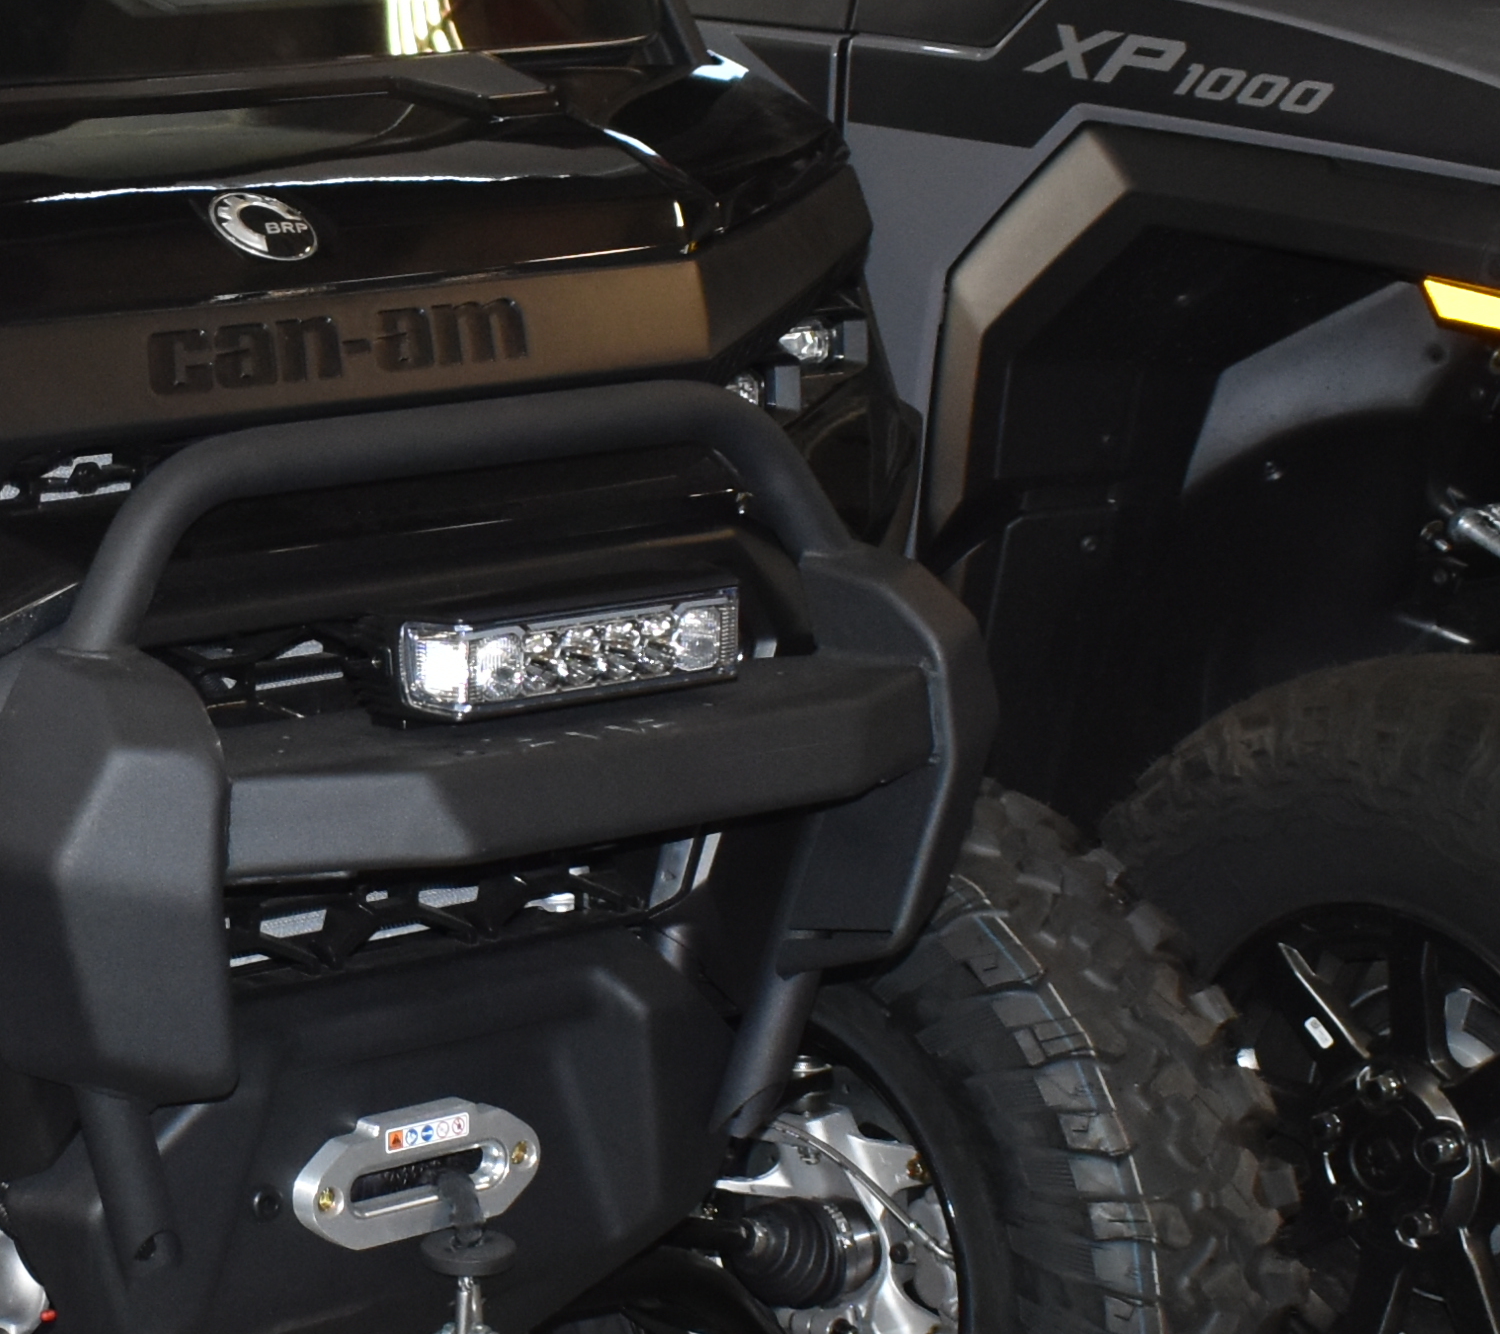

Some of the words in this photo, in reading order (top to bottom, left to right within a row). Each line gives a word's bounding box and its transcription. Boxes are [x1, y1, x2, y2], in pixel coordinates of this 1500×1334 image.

[1022, 23, 1187, 84] XP
[1173, 62, 1335, 115] 1000
[264, 221, 308, 235] BRP
[146, 296, 529, 396] can-am
